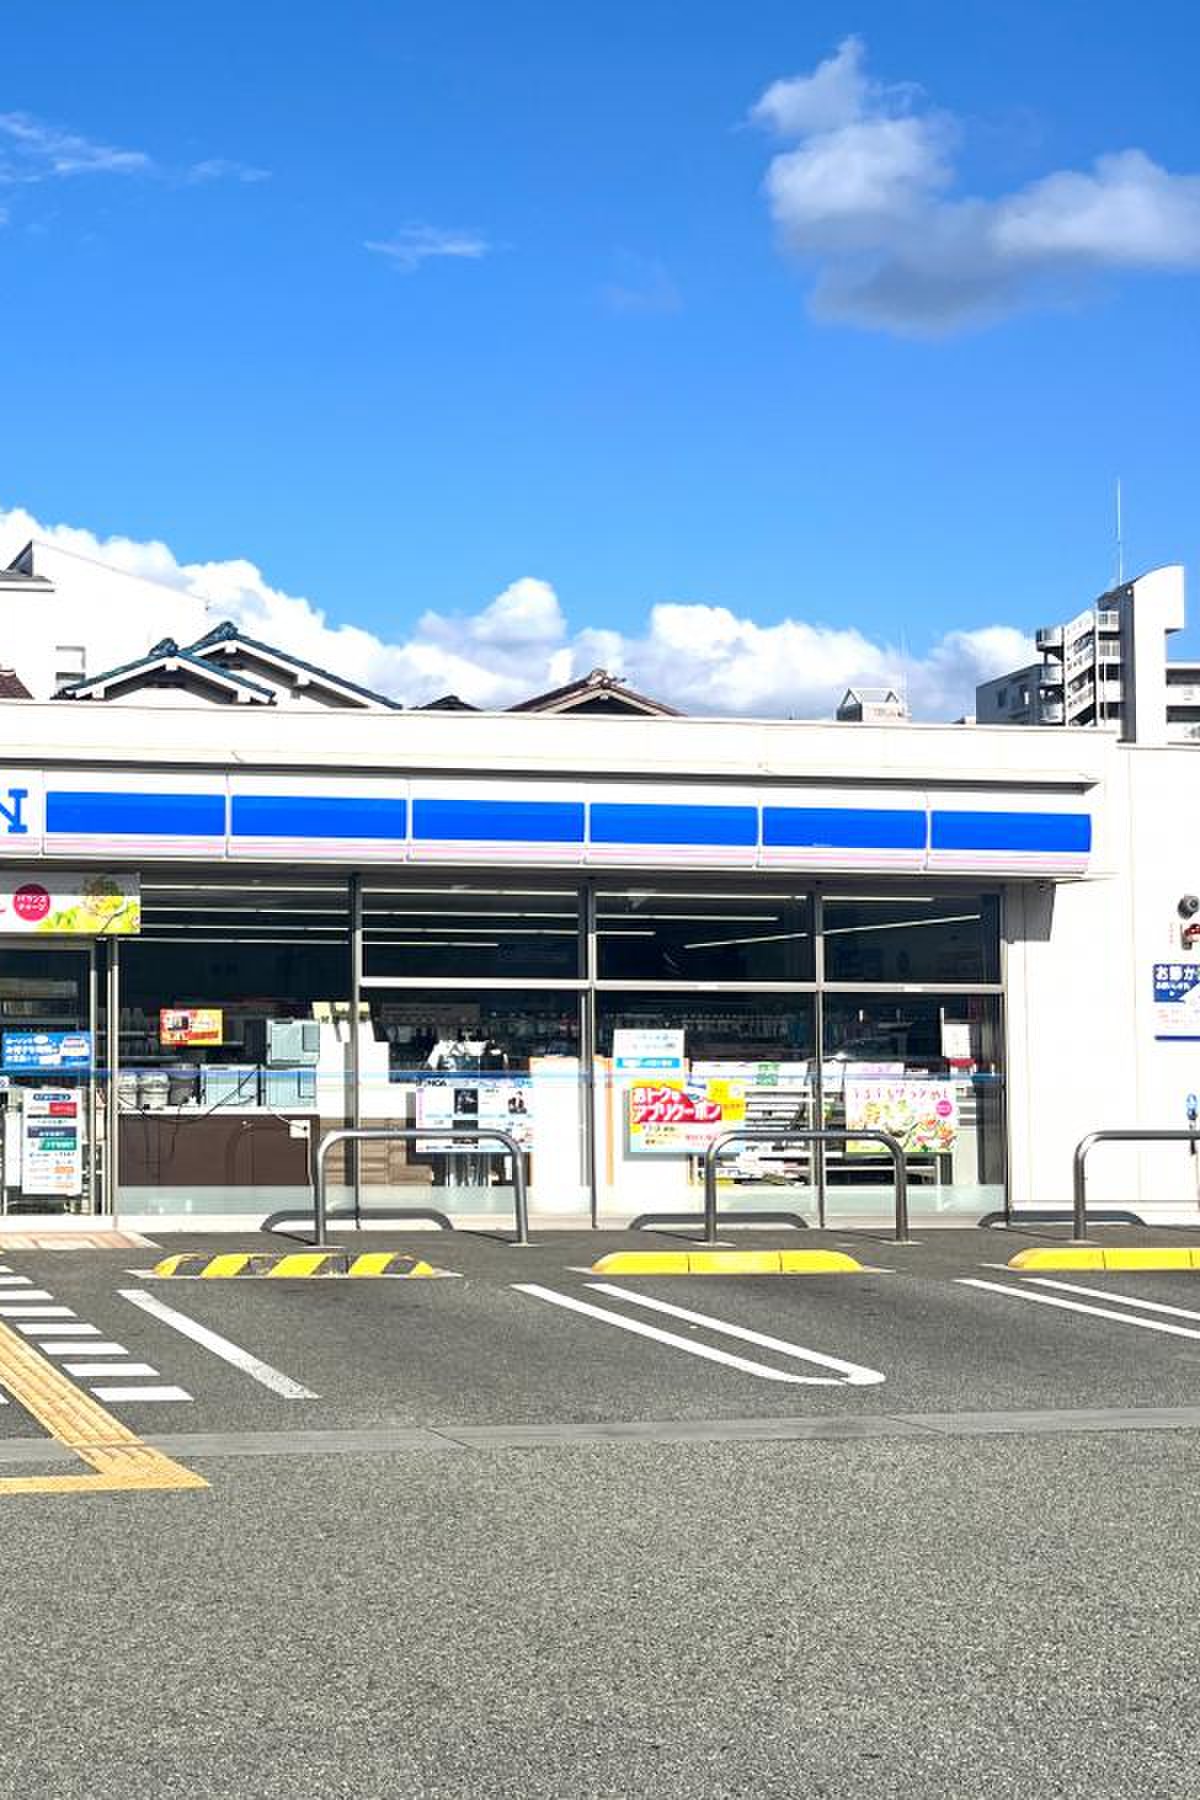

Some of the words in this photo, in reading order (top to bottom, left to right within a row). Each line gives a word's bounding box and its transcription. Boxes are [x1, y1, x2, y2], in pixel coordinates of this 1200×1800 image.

[631, 1102, 722, 1122] アプリクーポン
